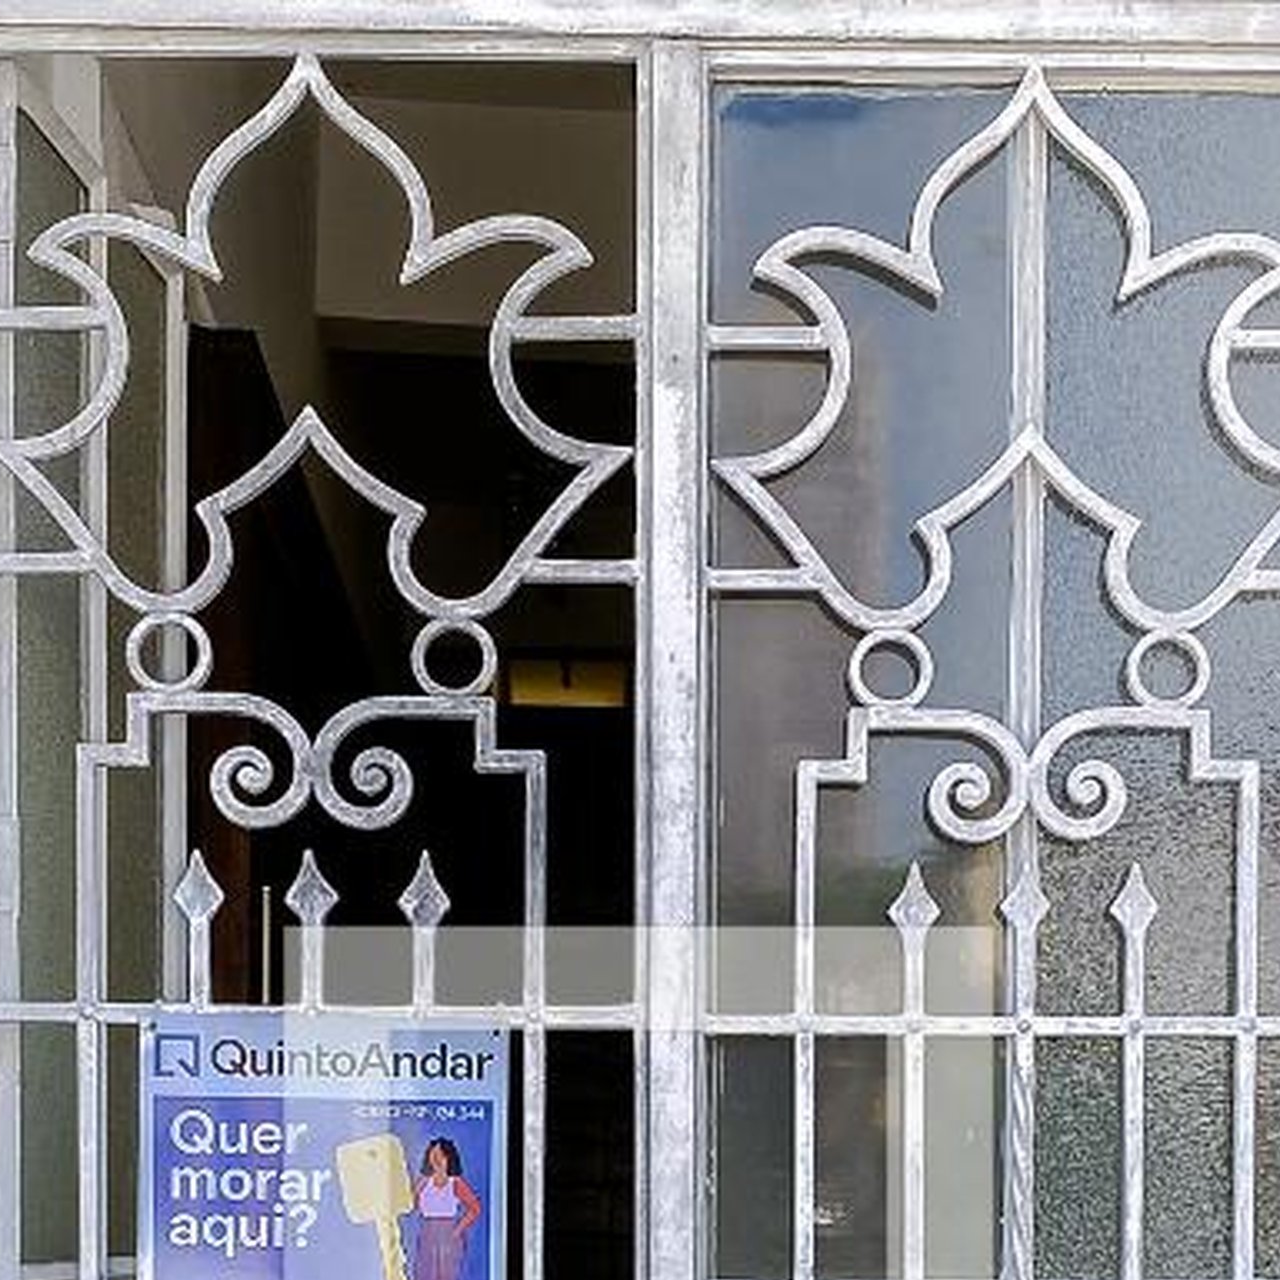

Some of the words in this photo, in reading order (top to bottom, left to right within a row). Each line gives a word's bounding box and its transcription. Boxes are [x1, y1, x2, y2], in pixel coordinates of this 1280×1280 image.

[210, 1039, 493, 1080] QuintoAndar
[170, 1109, 307, 1154] Quer
[171, 1165, 330, 1201] morar
[169, 1204, 318, 1257] aqui?
